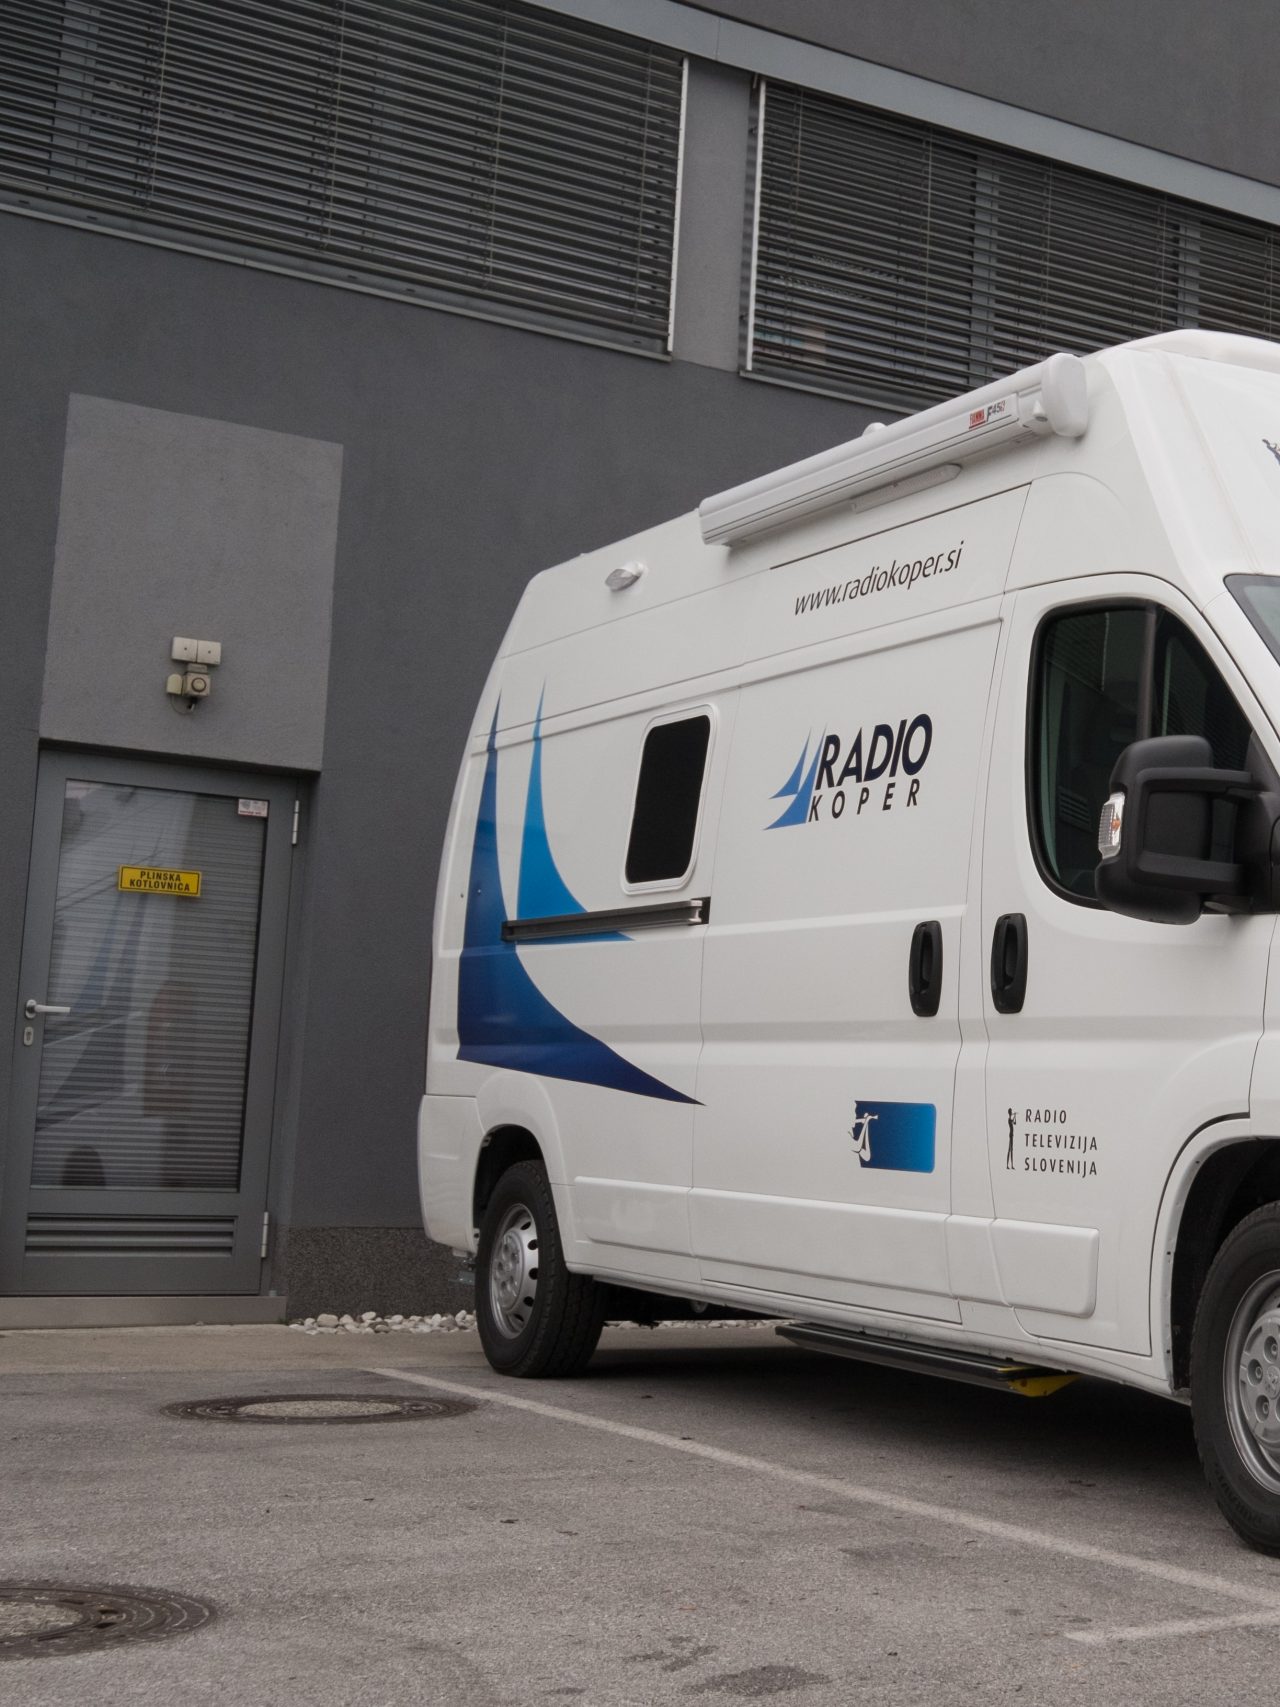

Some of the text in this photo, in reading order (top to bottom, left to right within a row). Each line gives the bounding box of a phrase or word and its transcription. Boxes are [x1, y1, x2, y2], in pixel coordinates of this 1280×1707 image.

[794, 540, 964, 616] www.radiokoper.si
[815, 713, 933, 790] RADIO
[808, 778, 920, 822] KOPER
[129, 878, 190, 892] KOTLOVNICA
[140, 870, 181, 882] PLINSKA
[1025, 1109, 1067, 1124] RADIO
[1024, 1133, 1098, 1154] TELEVIZIJA
[1024, 1157, 1098, 1179] SLOVENIJA
